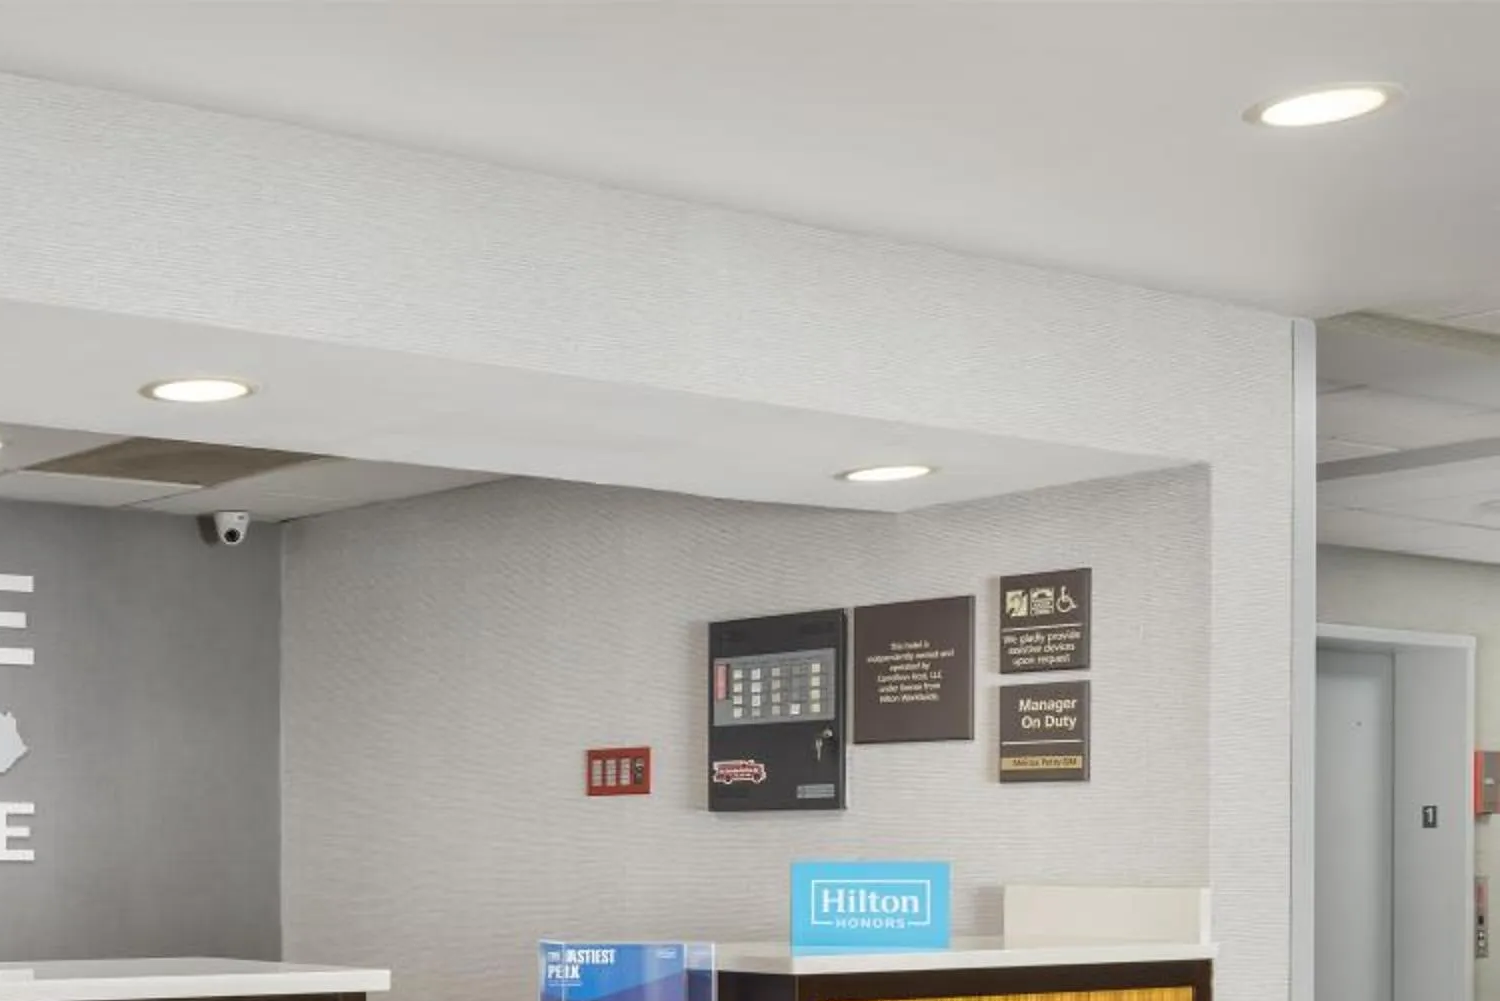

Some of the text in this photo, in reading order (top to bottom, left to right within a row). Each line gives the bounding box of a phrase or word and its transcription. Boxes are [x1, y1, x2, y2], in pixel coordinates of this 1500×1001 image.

[1047, 630, 1081, 645] provide
[1044, 643, 1075, 653] devices
[1018, 698, 1077, 712] Manager
[1021, 715, 1077, 731] On Duty
[822, 888, 920, 914] Hilton
[835, 917, 906, 929] HONORS
